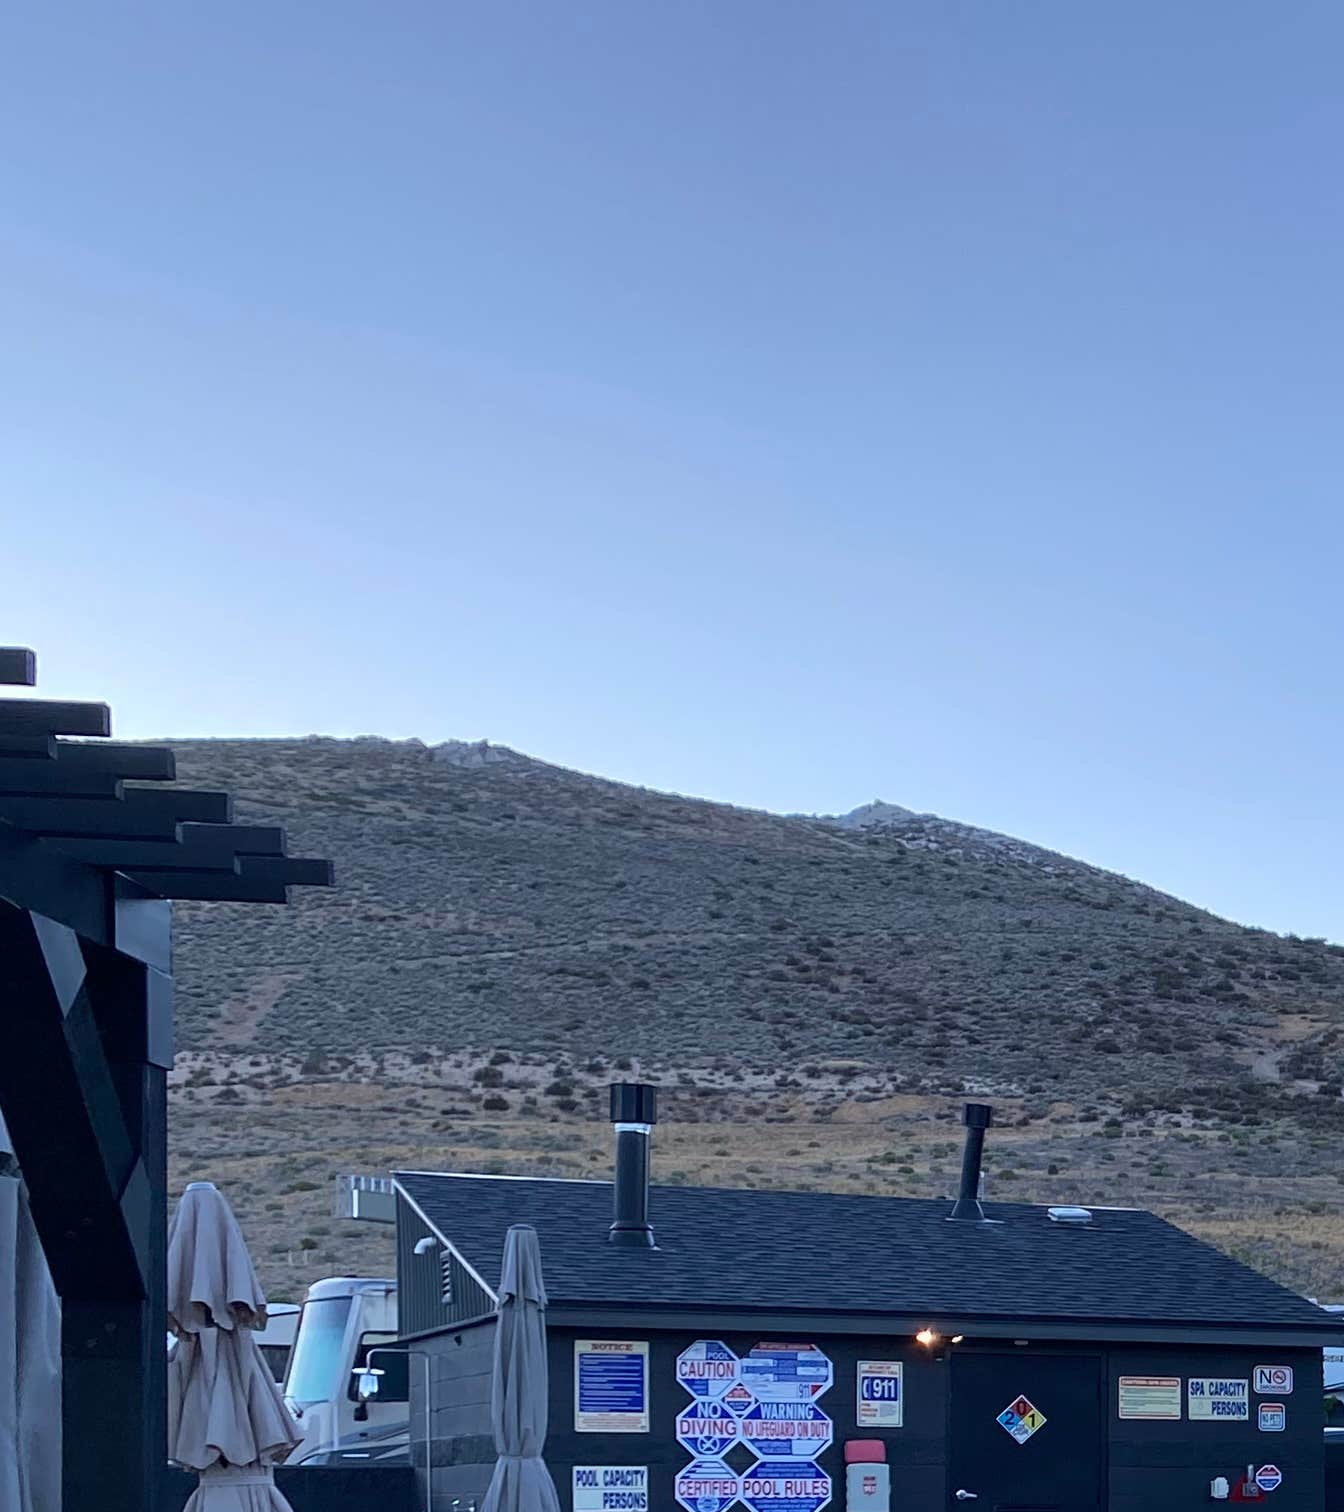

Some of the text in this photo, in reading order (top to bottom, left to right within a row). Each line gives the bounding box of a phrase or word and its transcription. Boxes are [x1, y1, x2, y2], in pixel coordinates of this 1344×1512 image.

[591, 1343, 633, 1352] NOTICE
[707, 1351, 731, 1361] POOL
[679, 1361, 735, 1378] CAUTION
[873, 1379, 896, 1399] 911
[1190, 1381, 1205, 1397] SPA
[1208, 1381, 1246, 1398] CAPACITY
[697, 1402, 722, 1419] NO
[760, 1402, 815, 1420] WARNING
[1210, 1400, 1247, 1417] PERSONS
[1004, 1410, 1015, 1426] 2
[1028, 1413, 1036, 1428] 1
[679, 1419, 737, 1436] DIVING
[742, 1421, 830, 1438] NO LIFEGUARD ON DUTY
[575, 1469, 646, 1487] POOL CAPACITY
[678, 1480, 738, 1497] CERTIFIED
[742, 1480, 830, 1496] POOL RULES
[602, 1492, 647, 1510] PERSONS
